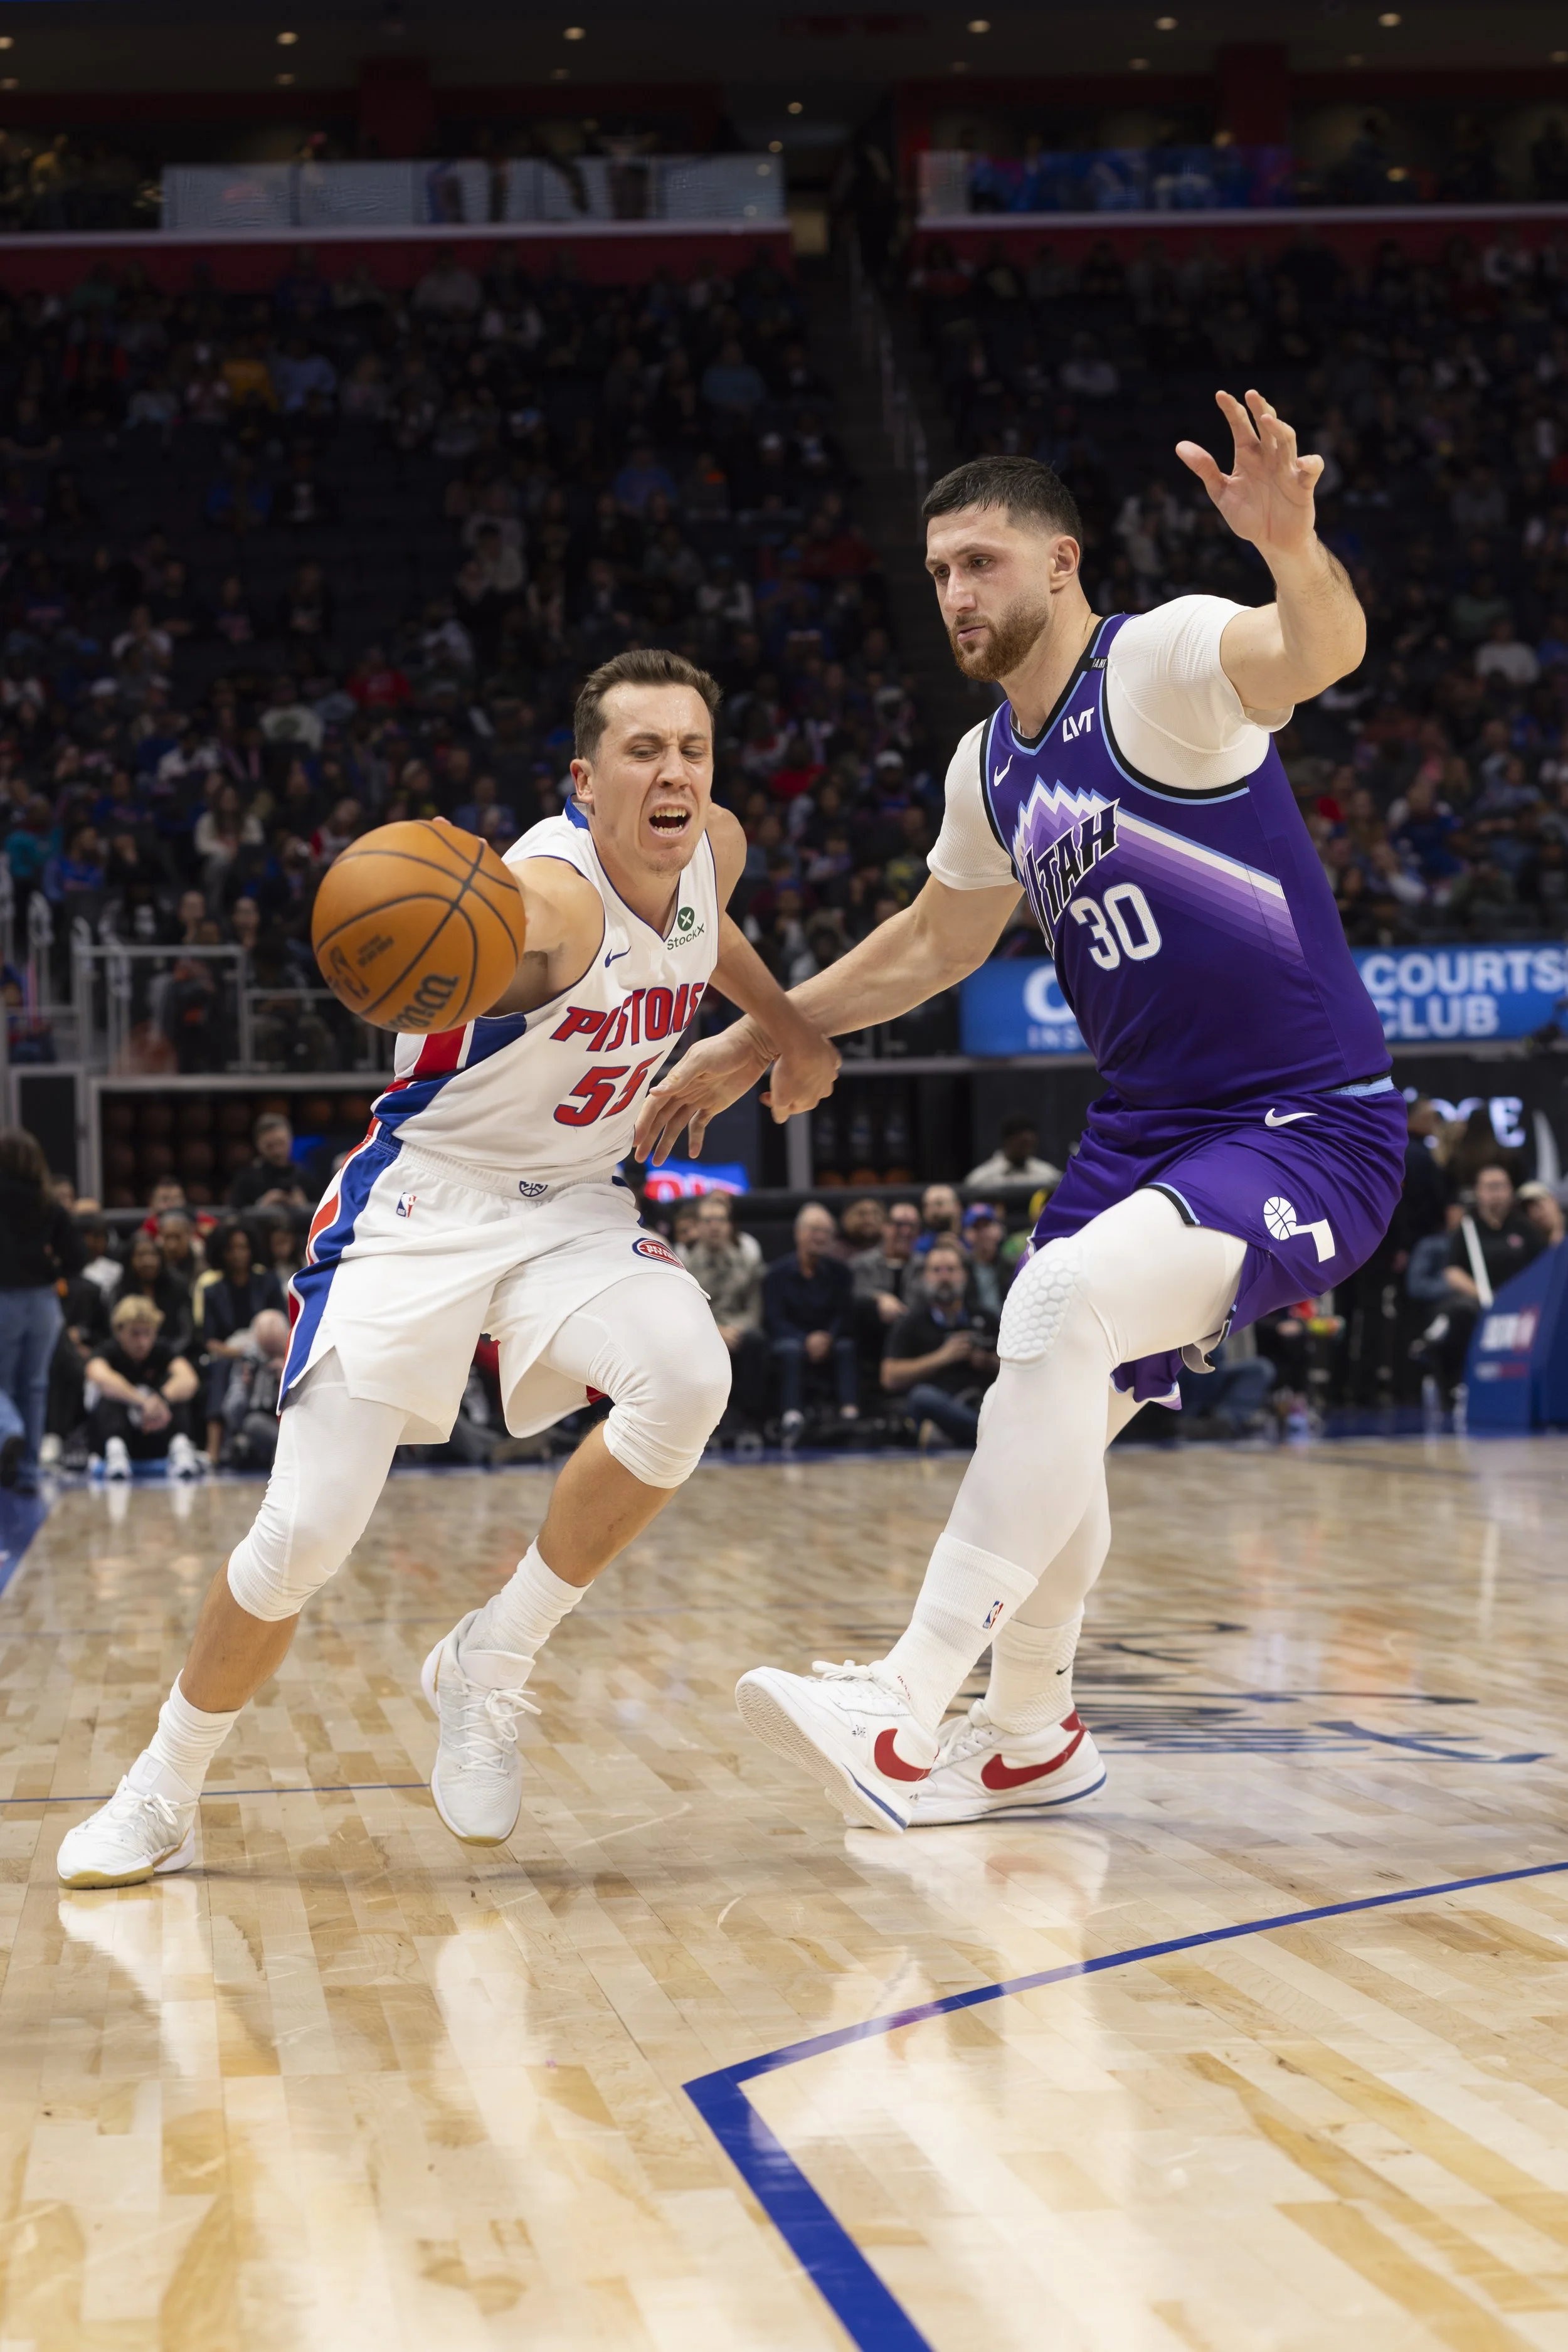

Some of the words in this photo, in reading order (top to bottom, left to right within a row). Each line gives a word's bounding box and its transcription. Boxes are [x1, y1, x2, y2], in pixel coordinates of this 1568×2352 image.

[1062, 706, 1095, 743] LVT
[1024, 798, 1120, 960] UTAH
[667, 923, 705, 950] StockX
[1069, 882, 1162, 971] 30
[1362, 948, 1568, 996] COURTS
[550, 982, 705, 1052] PISTONS
